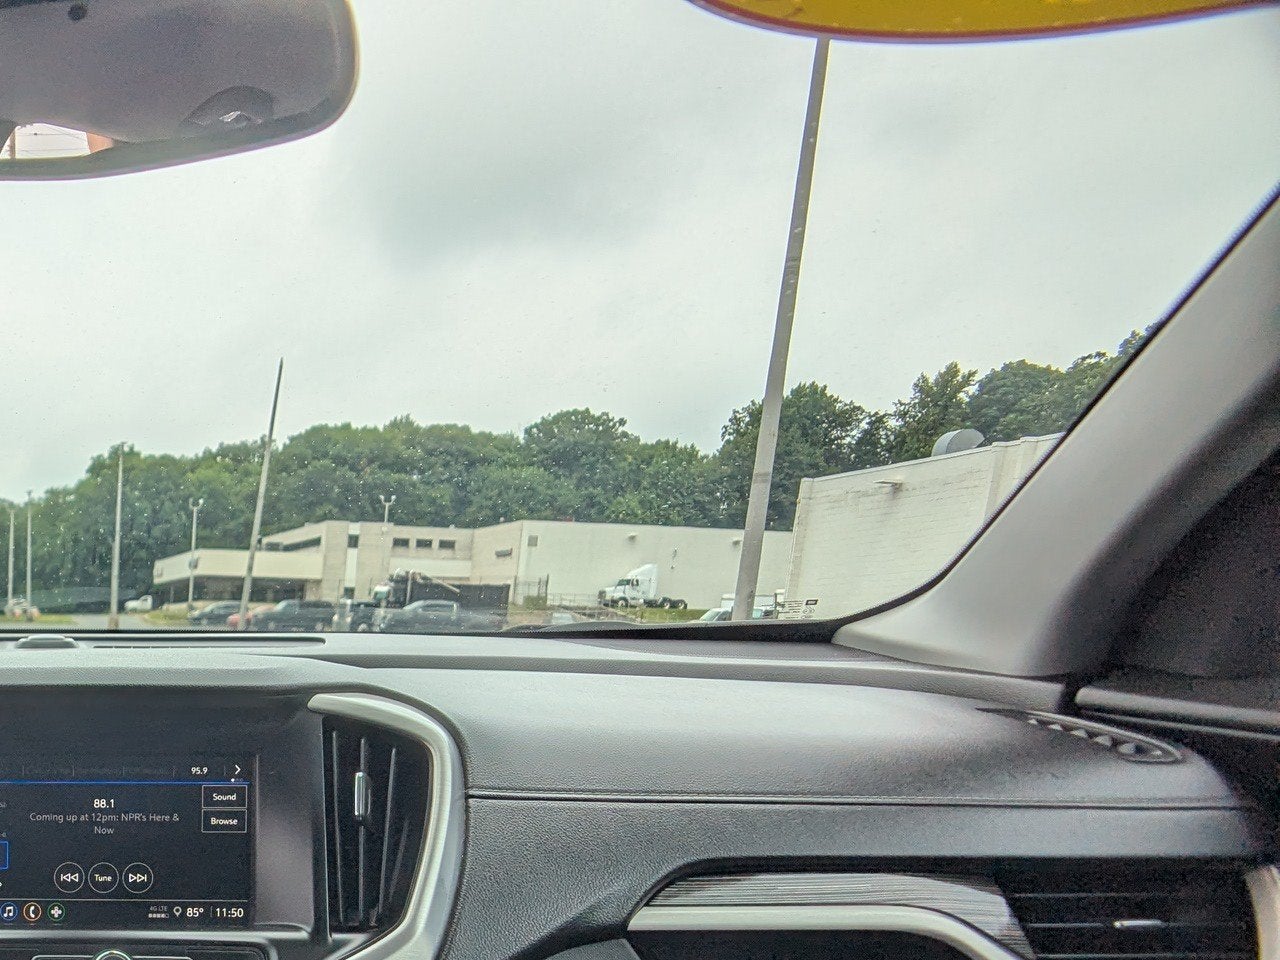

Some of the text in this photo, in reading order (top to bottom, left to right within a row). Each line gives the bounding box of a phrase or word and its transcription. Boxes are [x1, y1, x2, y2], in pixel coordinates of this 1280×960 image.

[191, 766, 208, 775] 95.9
[212, 792, 237, 801] Sound
[93, 798, 115, 809] 88.1
[29, 812, 180, 823] Coming up at 12pm: NPR's Here &
[210, 816, 238, 825] Browse
[94, 825, 114, 834] Now
[94, 873, 113, 882] Tune
[215, 907, 244, 918] 11:50
